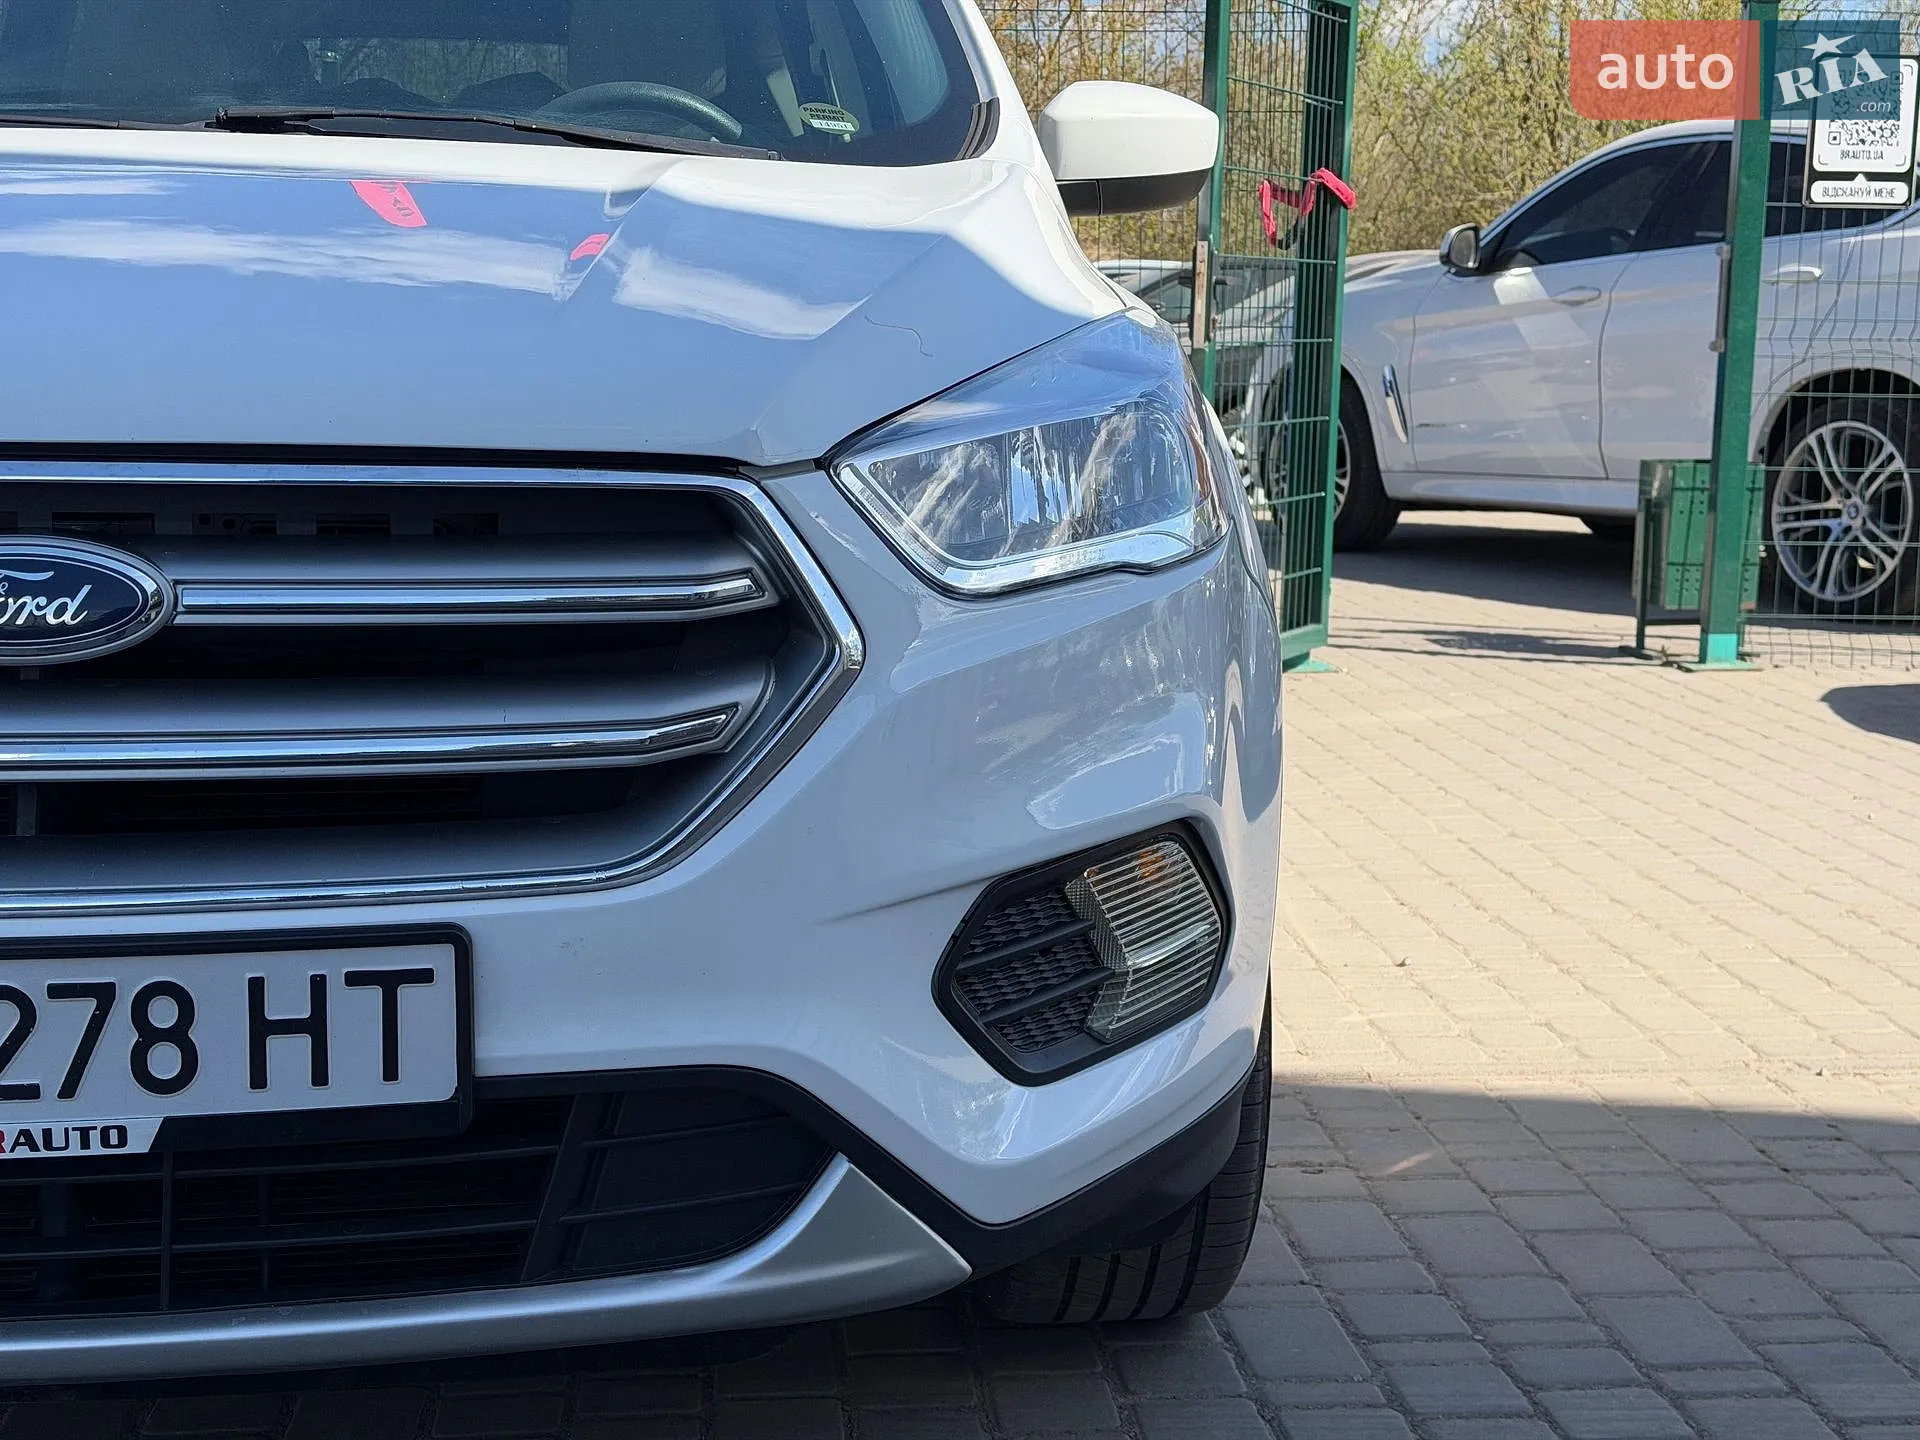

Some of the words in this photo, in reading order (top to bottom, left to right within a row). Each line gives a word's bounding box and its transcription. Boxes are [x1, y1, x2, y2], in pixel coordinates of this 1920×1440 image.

[803, 107, 845, 116] PARKING
[809, 113, 845, 121] PERMIT
[248, 967, 435, 1091] HT
[0, 1125, 128, 1154] AUTO
